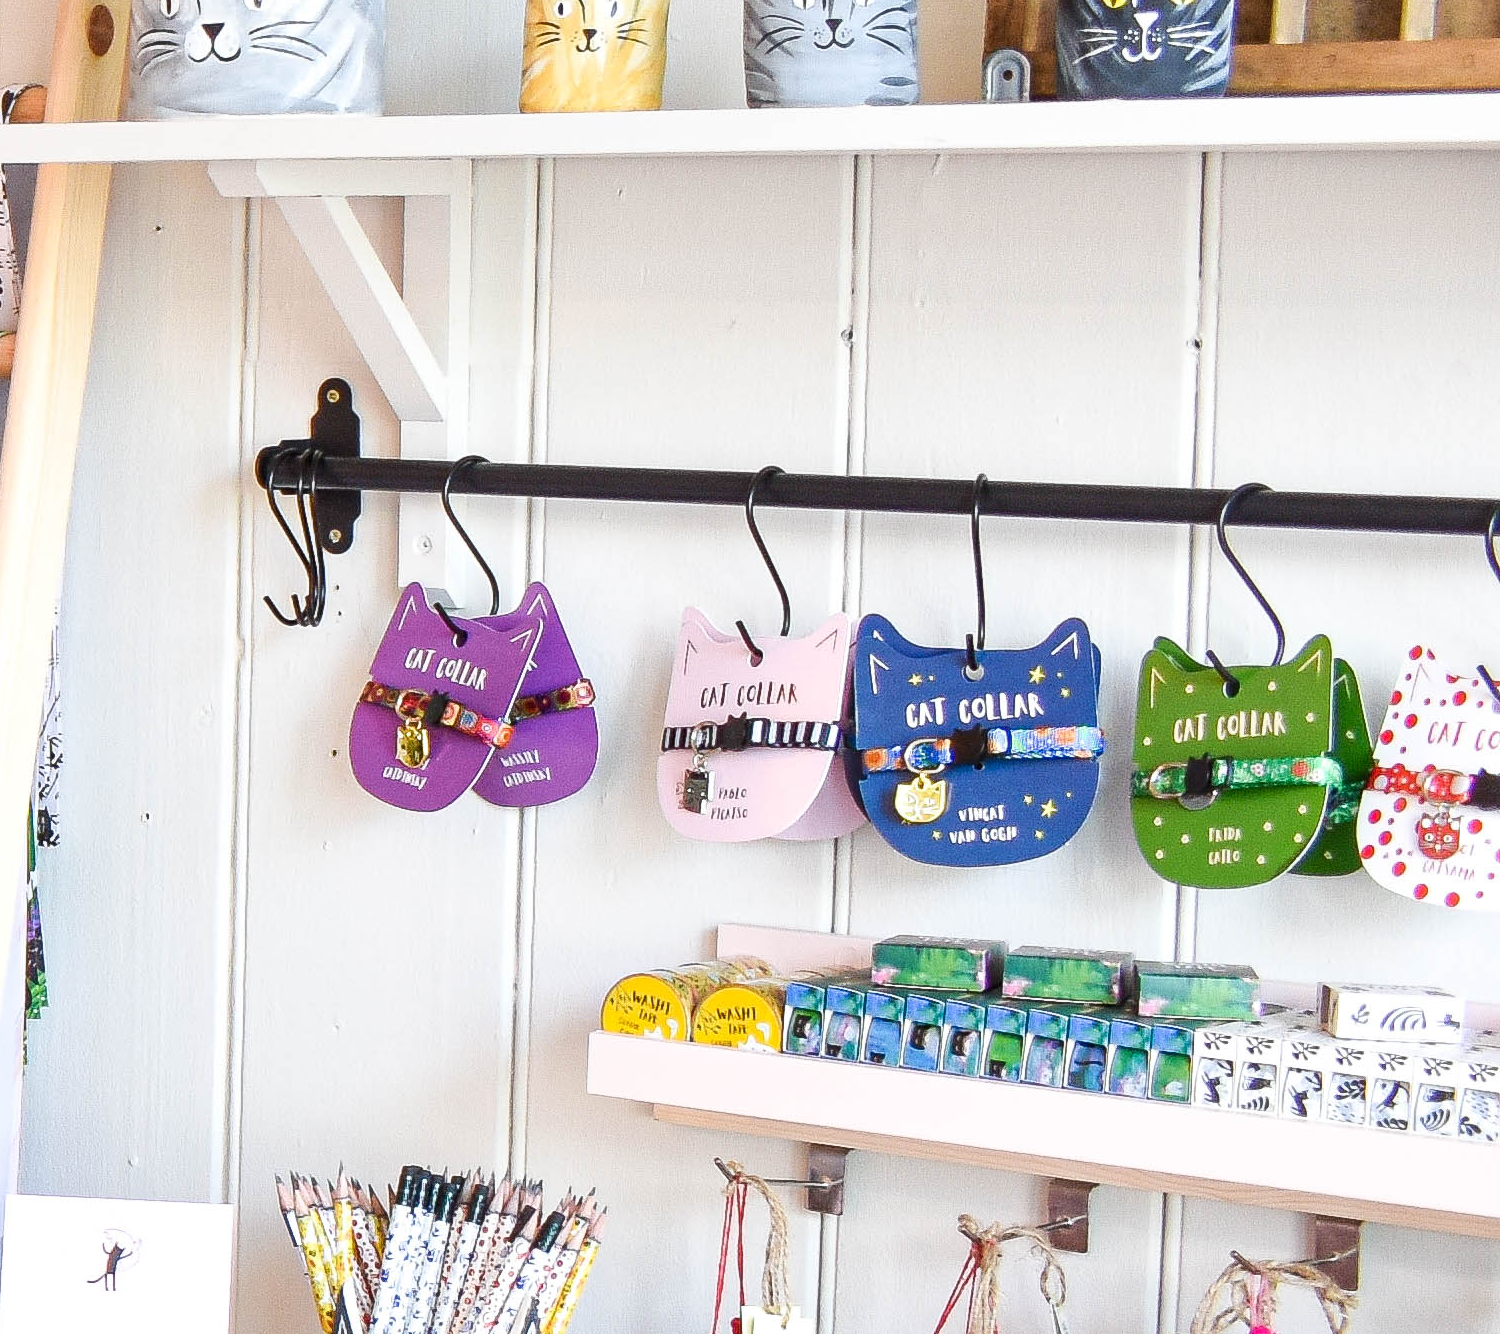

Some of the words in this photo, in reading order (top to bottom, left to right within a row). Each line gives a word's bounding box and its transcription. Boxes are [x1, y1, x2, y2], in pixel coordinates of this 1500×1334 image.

[404, 648, 436, 673] CAT
[435, 657, 487, 691] COLLAR
[700, 682, 730, 708] CAT
[737, 681, 798, 707] COLLAR
[905, 697, 946, 729] CAT
[958, 692, 1045, 724] COLLAR
[1173, 713, 1208, 744] CAT
[1216, 710, 1286, 741] COLLAR
[1427, 720, 1468, 747] CAT
[718, 787, 748, 800] PABLO
[958, 804, 1005, 822] VINCAT
[949, 829, 976, 845] VAN
[981, 826, 1018, 843] GOGH
[1208, 826, 1242, 843] FRIDA
[631, 990, 672, 1016] WASHI
[638, 1009, 659, 1025] TAPE
[716, 1006, 757, 1022] WASHI
[728, 1024, 748, 1036] TAPE
